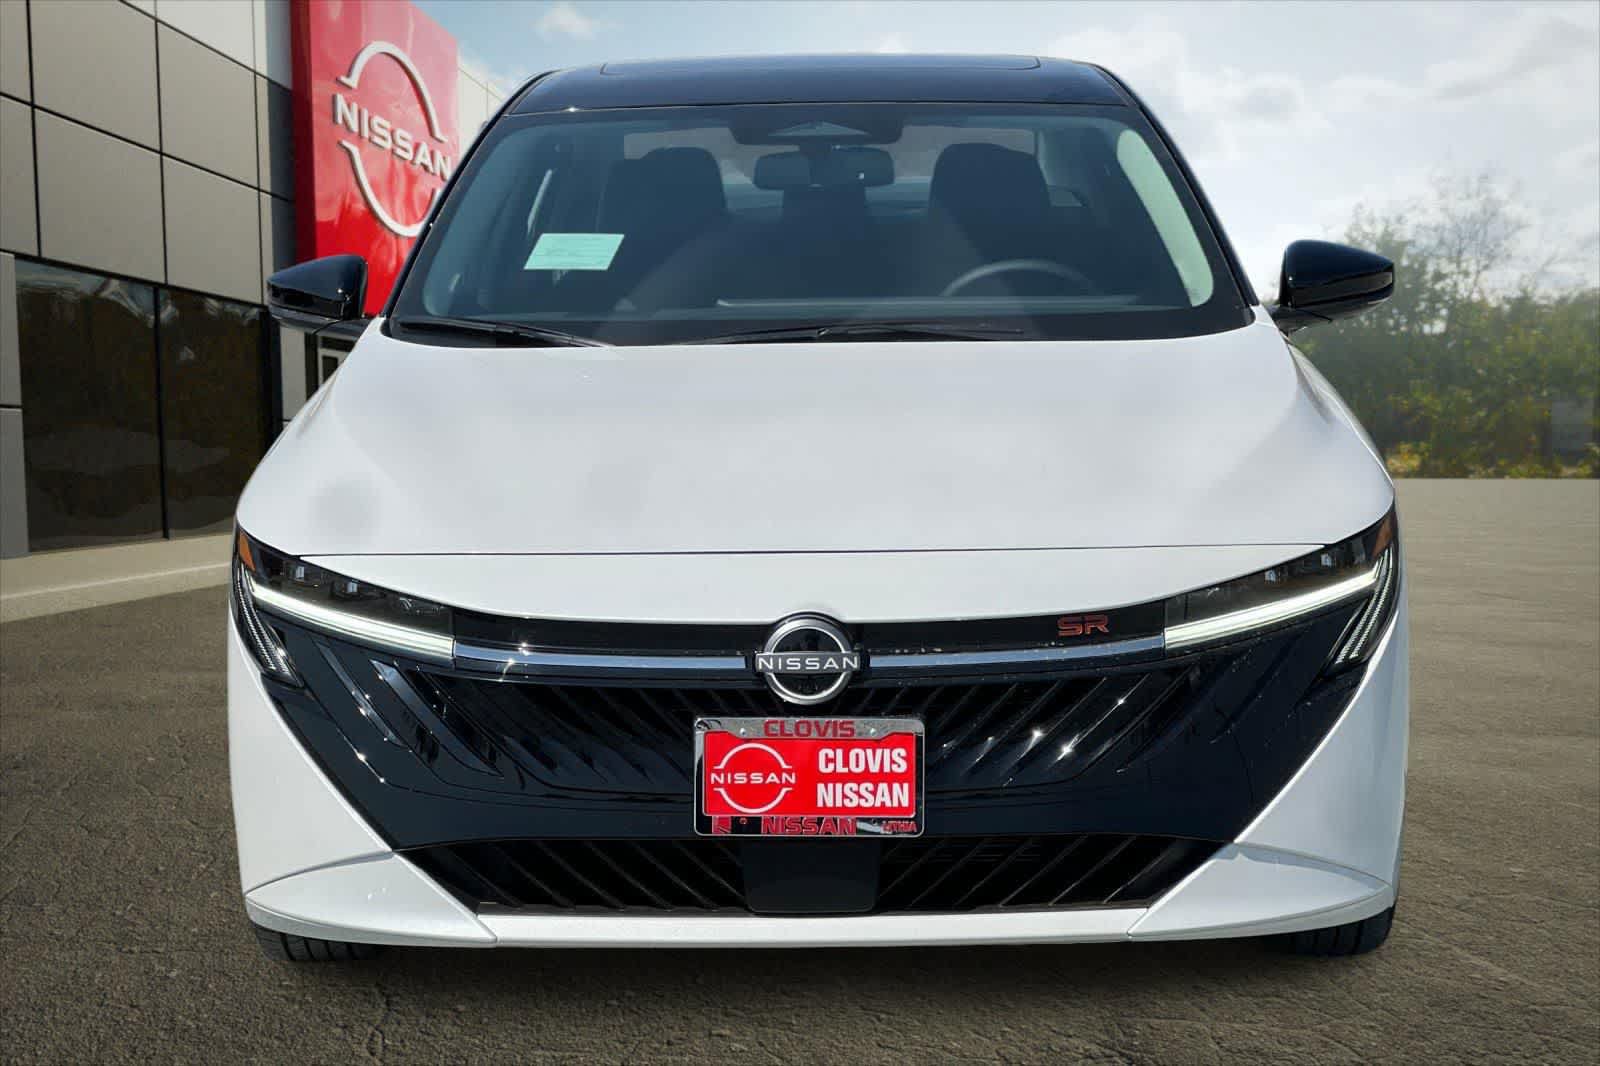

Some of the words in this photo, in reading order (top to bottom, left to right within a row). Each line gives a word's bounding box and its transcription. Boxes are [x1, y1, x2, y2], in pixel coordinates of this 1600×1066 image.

[333, 92, 451, 181] NISSAN
[1057, 614, 1109, 637] SR
[758, 656, 858, 670] NISSAN
[763, 719, 856, 737] CLOVIS
[818, 748, 908, 773] CLOVIS
[710, 772, 796, 784] NISSAN
[816, 782, 909, 807] NISSAN
[761, 816, 857, 835] NISSAN
